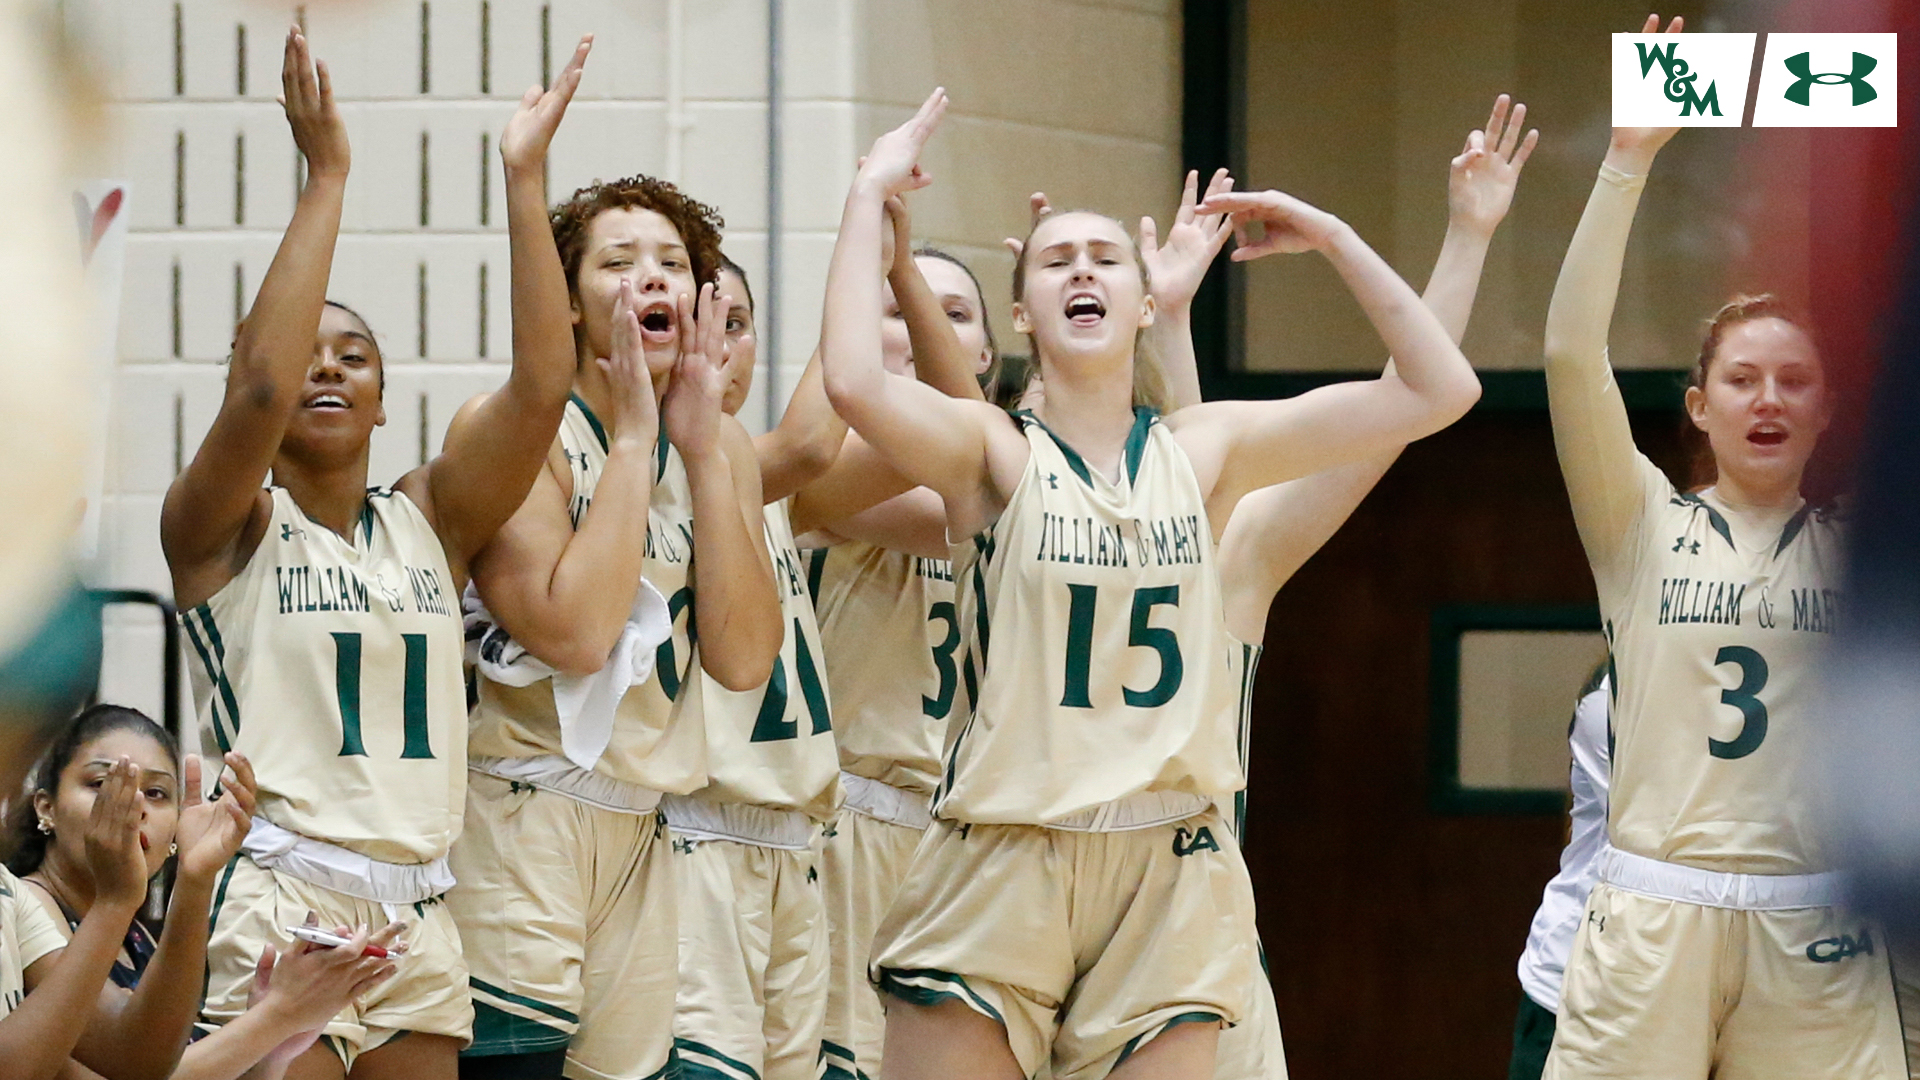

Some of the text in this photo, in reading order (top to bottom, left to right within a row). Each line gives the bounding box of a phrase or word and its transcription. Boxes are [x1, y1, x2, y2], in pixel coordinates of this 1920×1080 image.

[276, 565, 371, 615] WILLIAM
[1059, 583, 1184, 709] 15
[1658, 578, 1843, 635] WILLIAM & MAR
[330, 632, 437, 760] 11
[1708, 645, 1770, 760] 3
